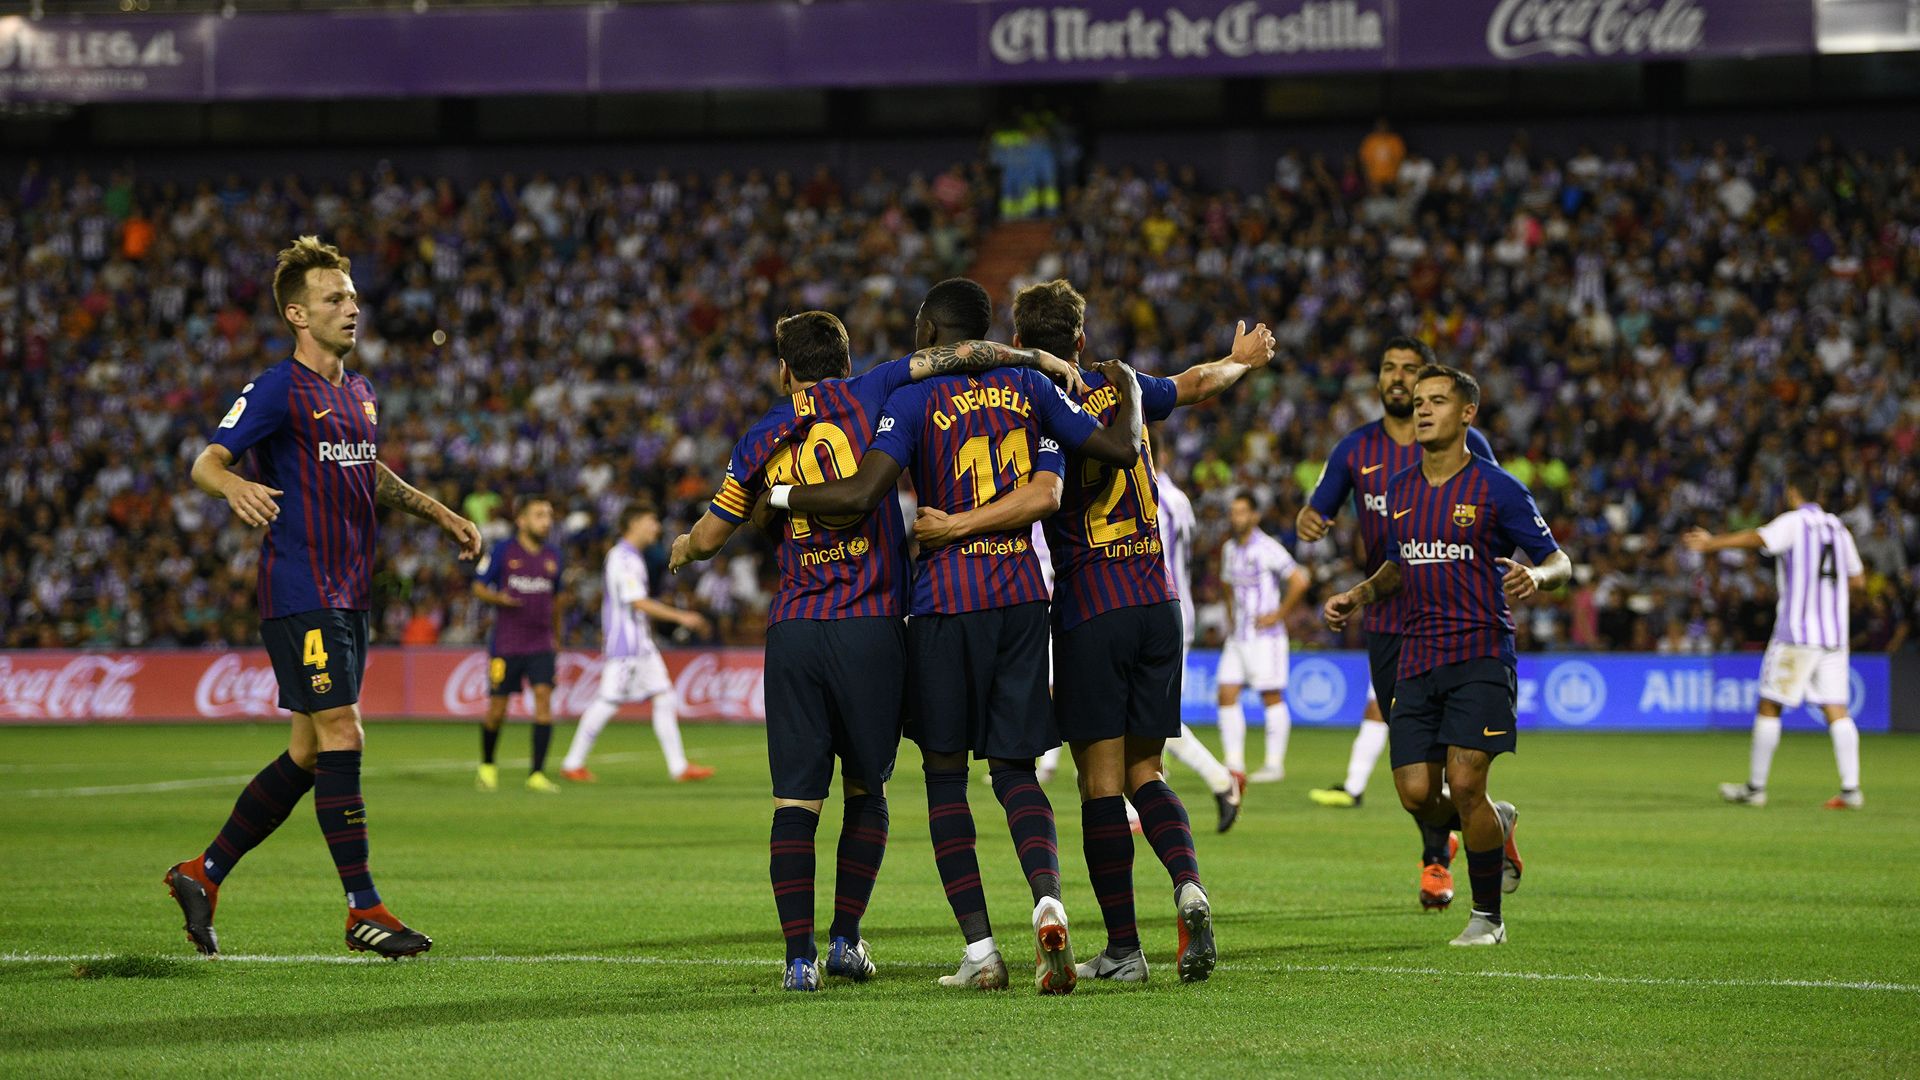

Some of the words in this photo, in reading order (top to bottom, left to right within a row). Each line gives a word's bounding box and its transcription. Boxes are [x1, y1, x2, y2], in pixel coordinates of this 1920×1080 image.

[990, 7, 1049, 63] El
[1052, 7, 1165, 62] Norte
[1166, 7, 1213, 59] de
[1213, 0, 1383, 57] Castilla
[1082, 385, 1122, 418] ROBE
[932, 410, 957, 431] O.
[318, 439, 377, 463] Rakute
[955, 427, 1032, 509] 11
[961, 538, 1015, 556] unicef
[303, 629, 329, 669] 4
[1639, 669, 1760, 714] Allian
